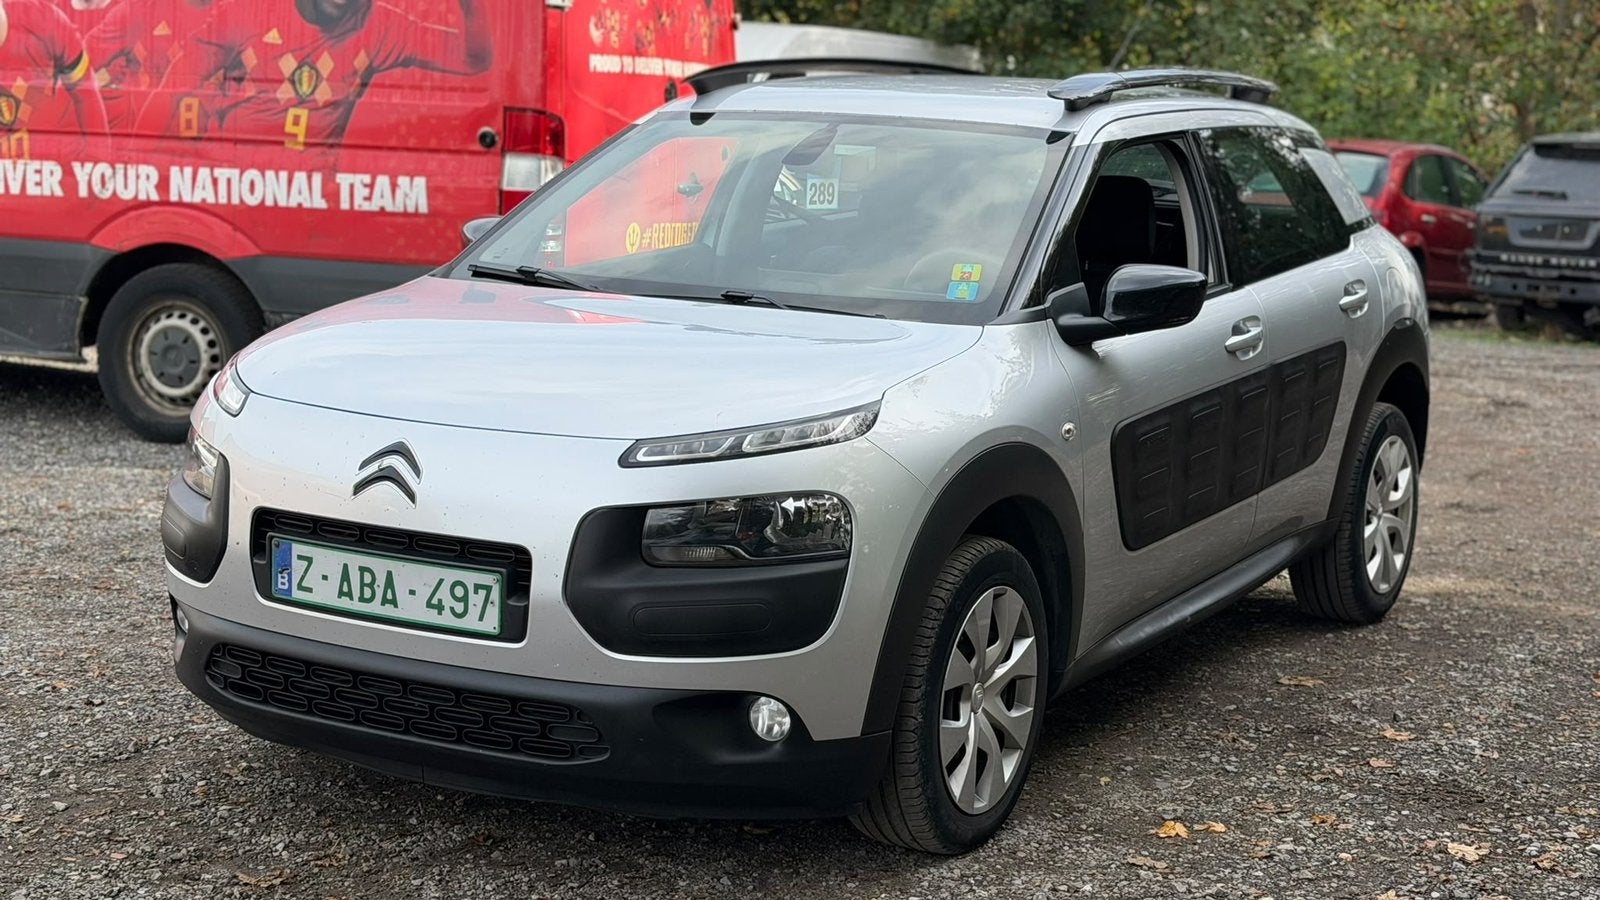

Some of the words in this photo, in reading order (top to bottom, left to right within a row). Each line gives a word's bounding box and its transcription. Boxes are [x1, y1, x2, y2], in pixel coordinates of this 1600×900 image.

[179, 97, 200, 137] 8
[284, 107, 309, 150] 9
[71, 161, 160, 201] YOUR
[169, 166, 328, 210] NATIONAL
[336, 173, 429, 214] TEAM
[809, 182, 835, 205] 289
[278, 572, 289, 590] B
[296, 554, 494, 622] Z-ABA-497
